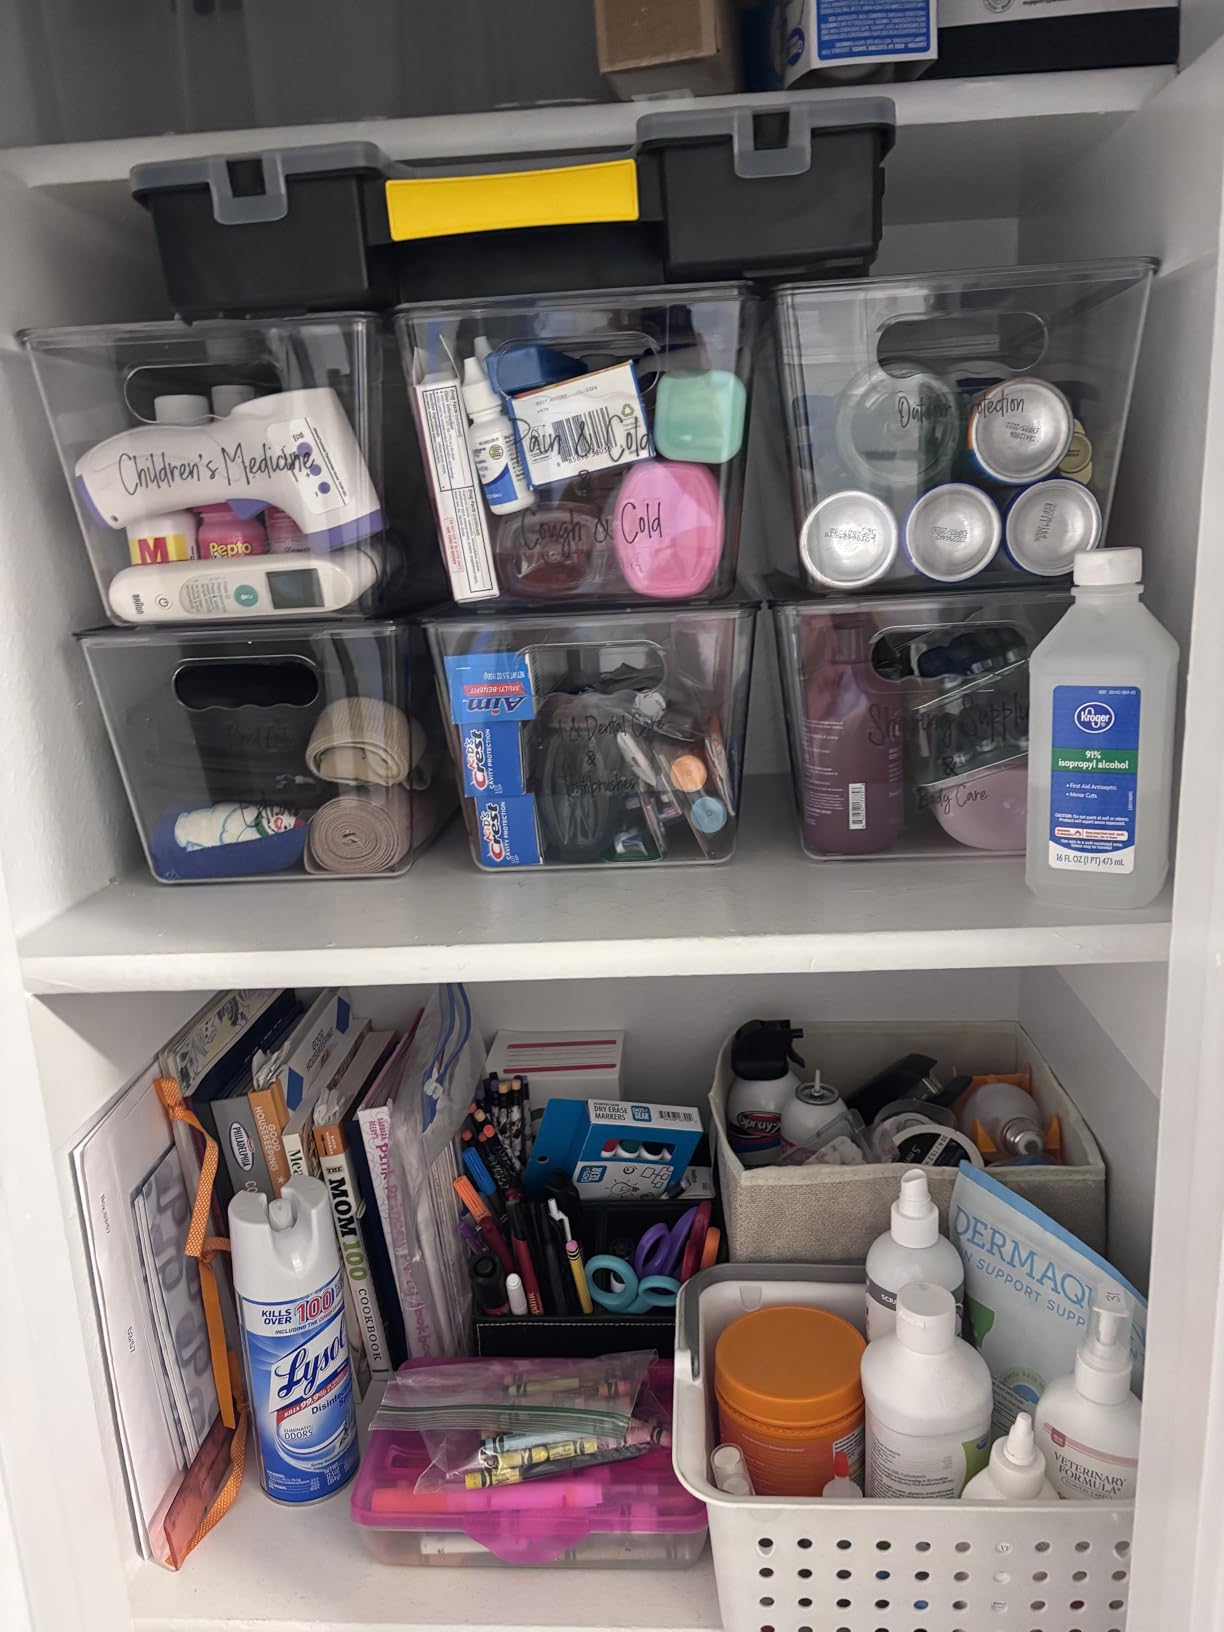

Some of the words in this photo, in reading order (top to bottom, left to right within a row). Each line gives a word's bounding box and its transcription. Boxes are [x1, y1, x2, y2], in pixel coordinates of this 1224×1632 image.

[508, 417, 562, 464] Pain
[576, 421, 594, 458] &
[607, 414, 657, 463] Cold
[118, 453, 219, 496] Children's
[221, 442, 316, 486] Medicine
[521, 510, 582, 557] Cough
[594, 514, 616, 544] &
[620, 502, 662, 544] Cold
[208, 541, 252, 559] Pepto
[466, 696, 528, 716] Aim
[1081, 707, 1110, 728] Kroger
[470, 729, 487, 791] Crest
[485, 729, 494, 764] PROTECTION
[585, 750, 597, 767] &
[1085, 750, 1101, 759] 91%
[488, 765, 496, 790] CAVITY
[1058, 758, 1096, 770] isopropyl
[1098, 760, 1129, 770] alcohol
[956, 784, 990, 808] Care
[1069, 782, 1081, 790] First
[500, 802, 509, 834] PROTECTION
[485, 803, 504, 861] Crest
[504, 835, 512, 860] CAVITY
[1056, 853, 1063, 862] 16
[1064, 854, 1072, 863] FL
[1072, 855, 1082, 864] OZ
[1090, 856, 1100, 866] PT)
[1102, 857, 1114, 866] 473
[593, 1105, 608, 1114] DRY
[608, 1106, 629, 1116] ERASE
[594, 1112, 627, 1122] MARKERS
[232, 1125, 251, 1168] PHILADELPHIA
[254, 1105, 279, 1172] HOUSEKEEPING
[268, 1123, 281, 1153] GOOD
[329, 1176, 357, 1238] MOM
[342, 1240, 367, 1282] 100
[975, 1257, 1042, 1303] SUPPORT
[261, 1308, 292, 1318] KILLS
[263, 1316, 292, 1325] OVER
[296, 1290, 332, 1324] 100
[275, 1324, 307, 1335] INCLUDING
[357, 1287, 383, 1362] COOKBOOK
[274, 1326, 346, 1398] Lysol
[284, 1406, 300, 1418] KILLS
[284, 1429, 313, 1440] ODORS
[1054, 1452, 1127, 1487] VETERINARY
